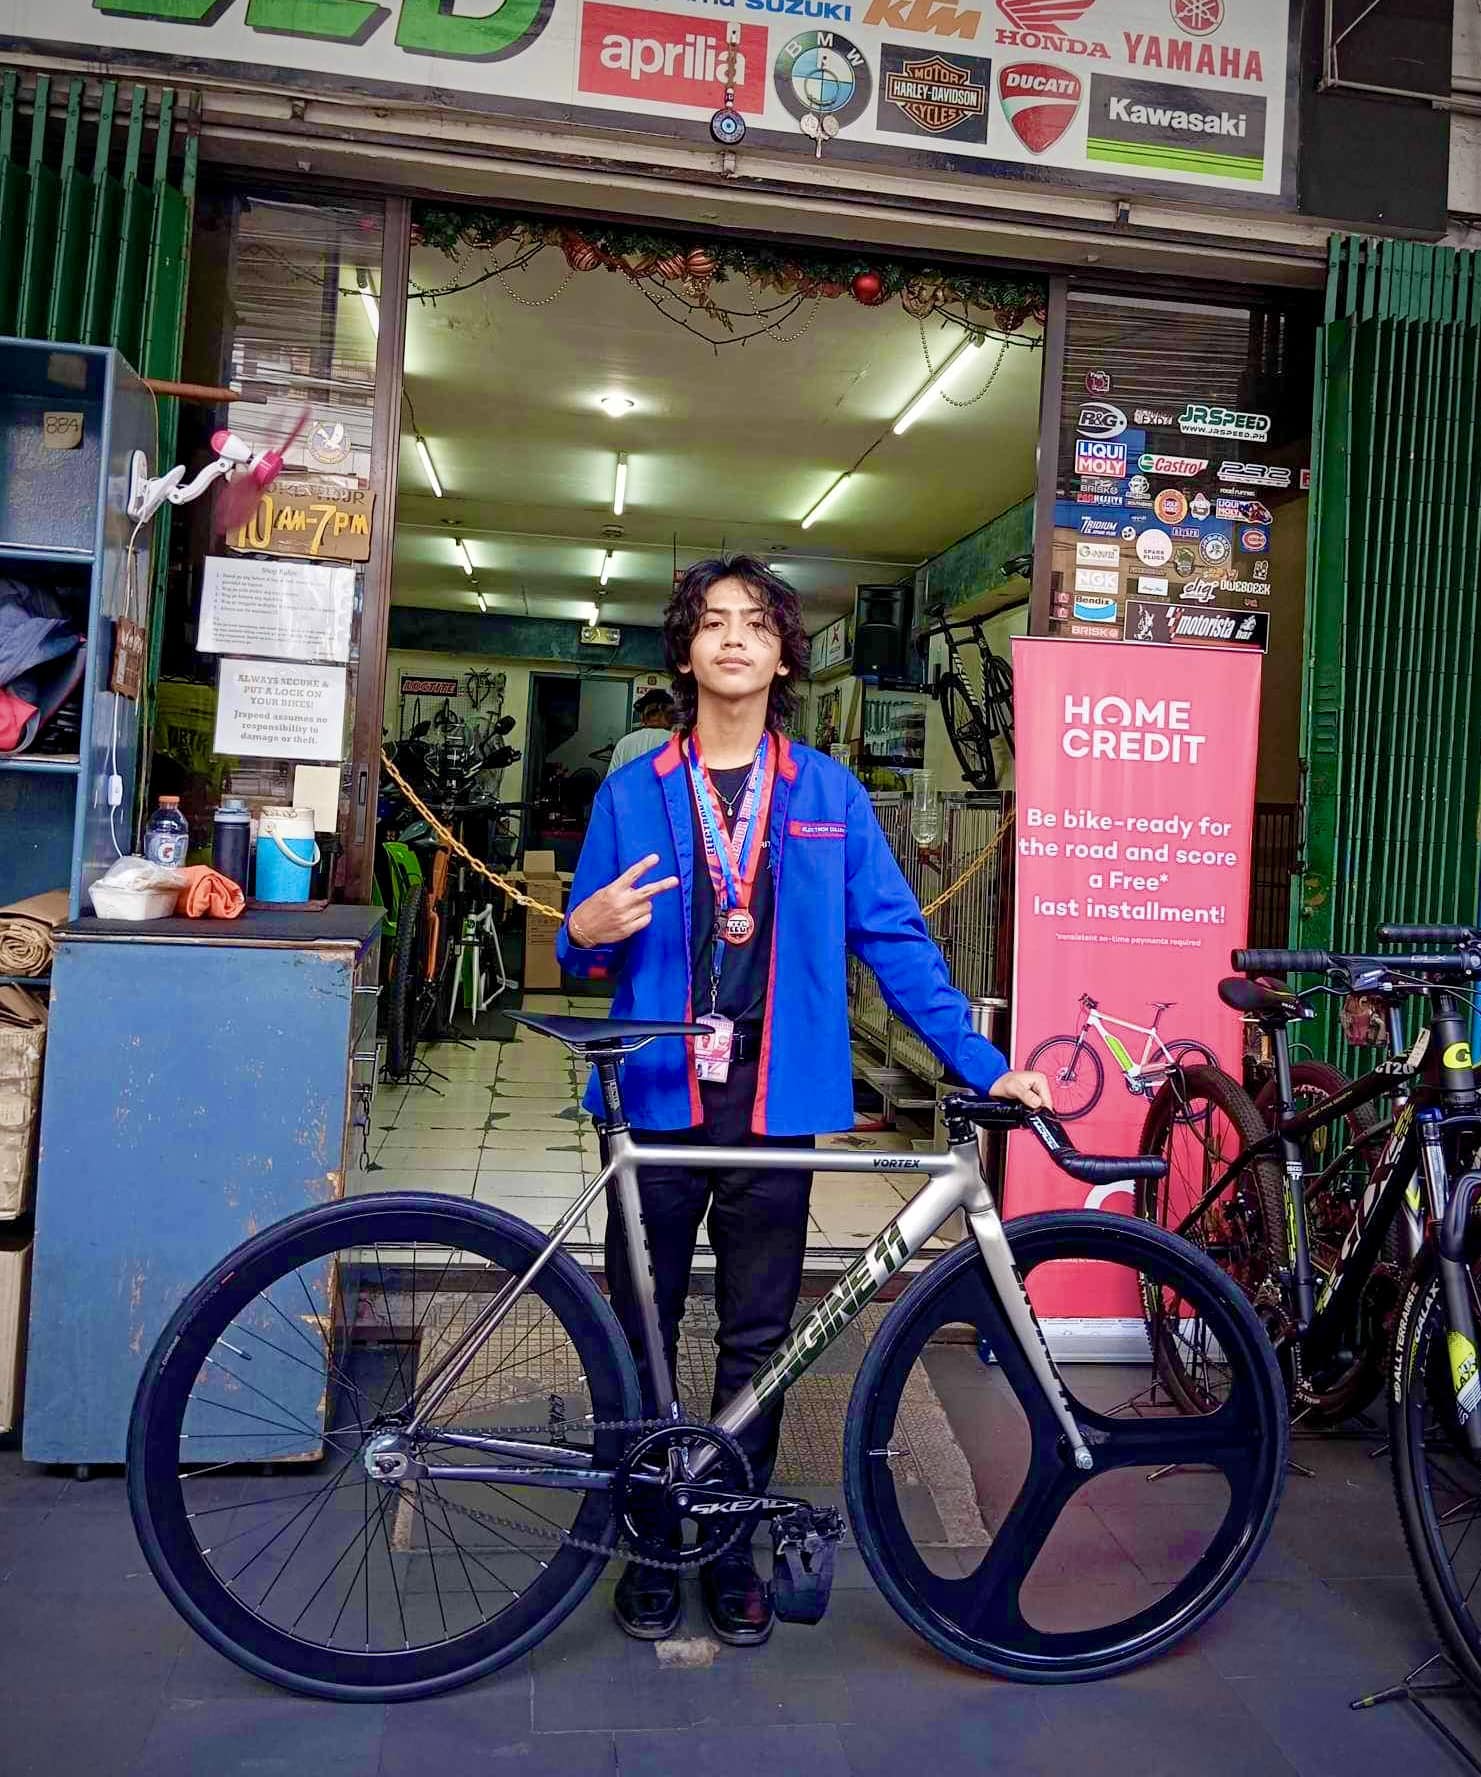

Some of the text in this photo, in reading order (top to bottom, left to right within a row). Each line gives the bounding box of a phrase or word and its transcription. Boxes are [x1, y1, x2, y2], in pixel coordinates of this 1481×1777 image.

[862, 0, 982, 40] KTM
[995, 28, 1111, 60] HONDA
[1123, 31, 1263, 82] YAMAHA
[600, 34, 746, 86] aprilia
[914, 66, 959, 84] MOTOR
[1006, 73, 1077, 94] DUCATI
[893, 81, 977, 107] HARLEY-DAVIDSON
[911, 103, 957, 125] CYCLES
[1109, 97, 1246, 137] Kawasaki
[1079, 409, 1119, 427] R&G
[1181, 405, 1268, 430] JRSPEED
[1080, 443, 1124, 459] LIQUI
[1079, 458, 1124, 475] MOLY
[1080, 570, 1115, 590] NGK
[1175, 613, 1235, 639] motorista
[238, 674, 278, 685] ALWAYS
[250, 697, 279, 707] YOUR
[275, 687, 304, 697] LOCK
[306, 689, 322, 698] ON
[272, 712, 314, 723] assumes
[1064, 695, 1192, 730] HOME
[240, 732, 279, 743] damage
[280, 734, 291, 742] or
[241, 721, 308, 734] responsibility
[1062, 728, 1207, 764] CREDIT
[1027, 808, 1232, 840] Be bike-ready for
[1019, 837, 1238, 866] the road and score
[1089, 874, 1103, 889] a
[1034, 896, 1225, 924] last installment!
[873, 1159, 920, 1169] VORTEX
[1395, 1290, 1416, 1352] TERRAINS
[1415, 1280, 1440, 1343] GALAX
[1393, 1354, 1403, 1379] ALL
